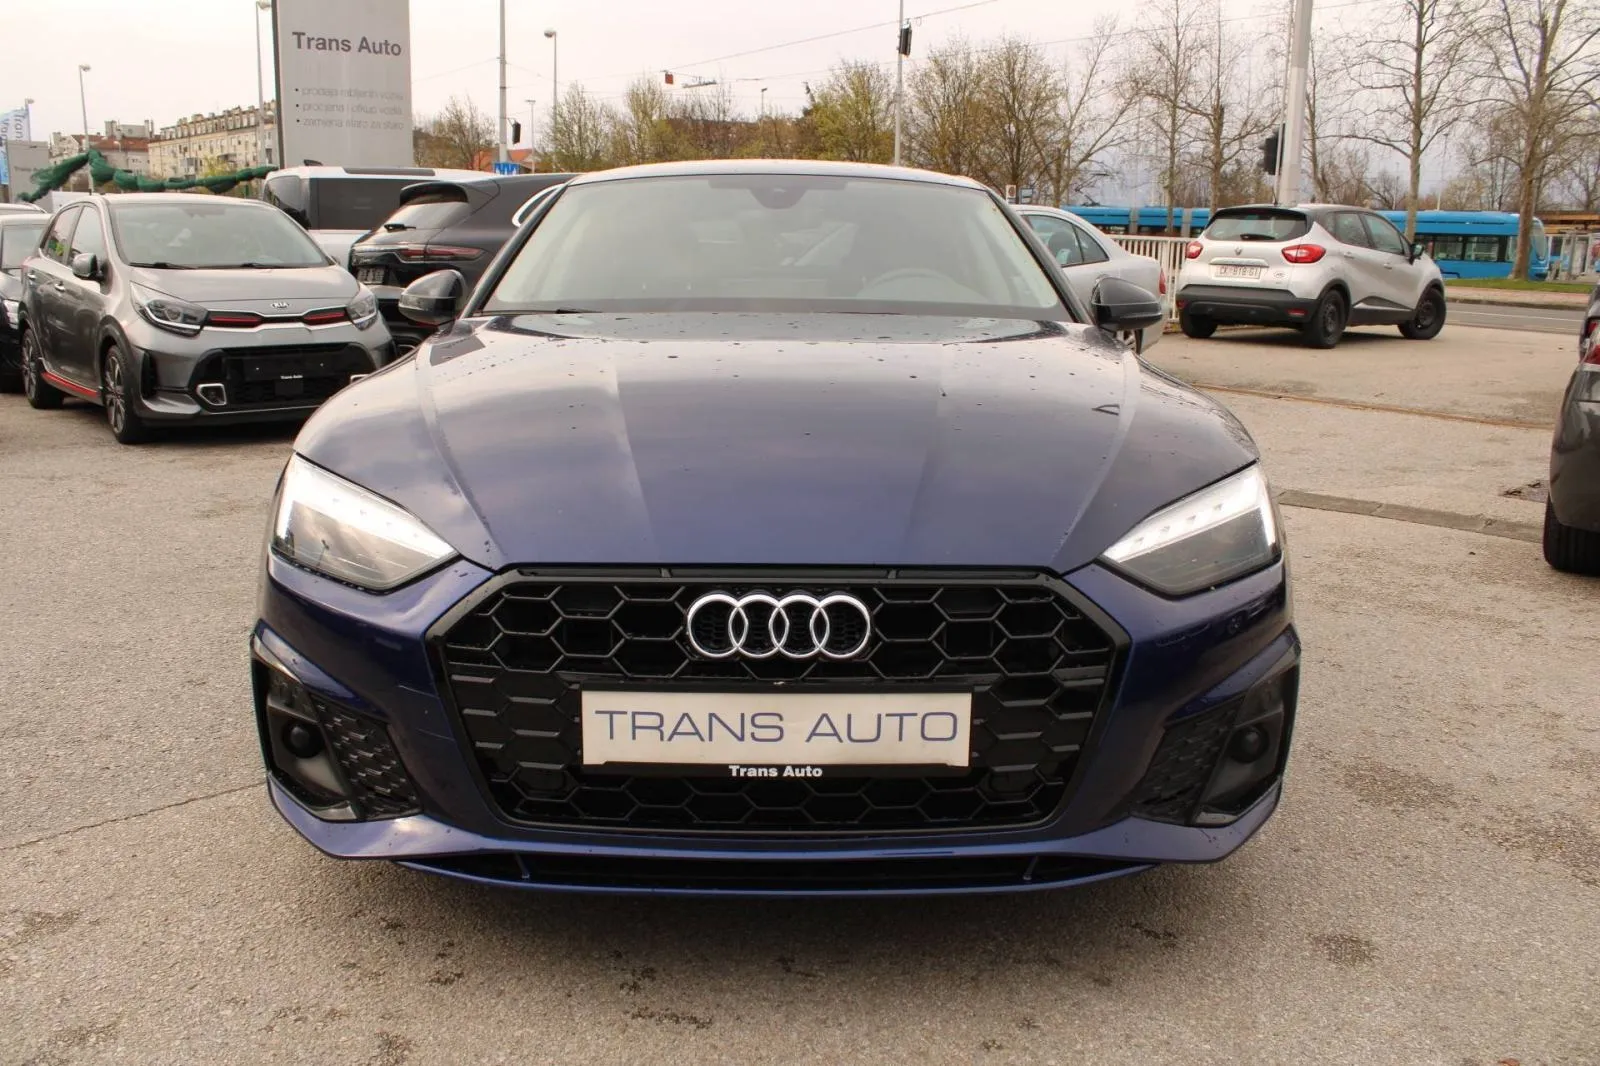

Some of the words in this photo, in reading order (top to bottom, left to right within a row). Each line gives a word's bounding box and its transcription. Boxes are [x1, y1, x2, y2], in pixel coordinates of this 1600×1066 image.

[292, 31, 352, 53] Trans
[357, 36, 402, 56] Auto
[595, 709, 784, 743] TRANS
[805, 711, 958, 743] AUTO
[729, 765, 778, 777] Trans
[783, 765, 823, 777] Auto
